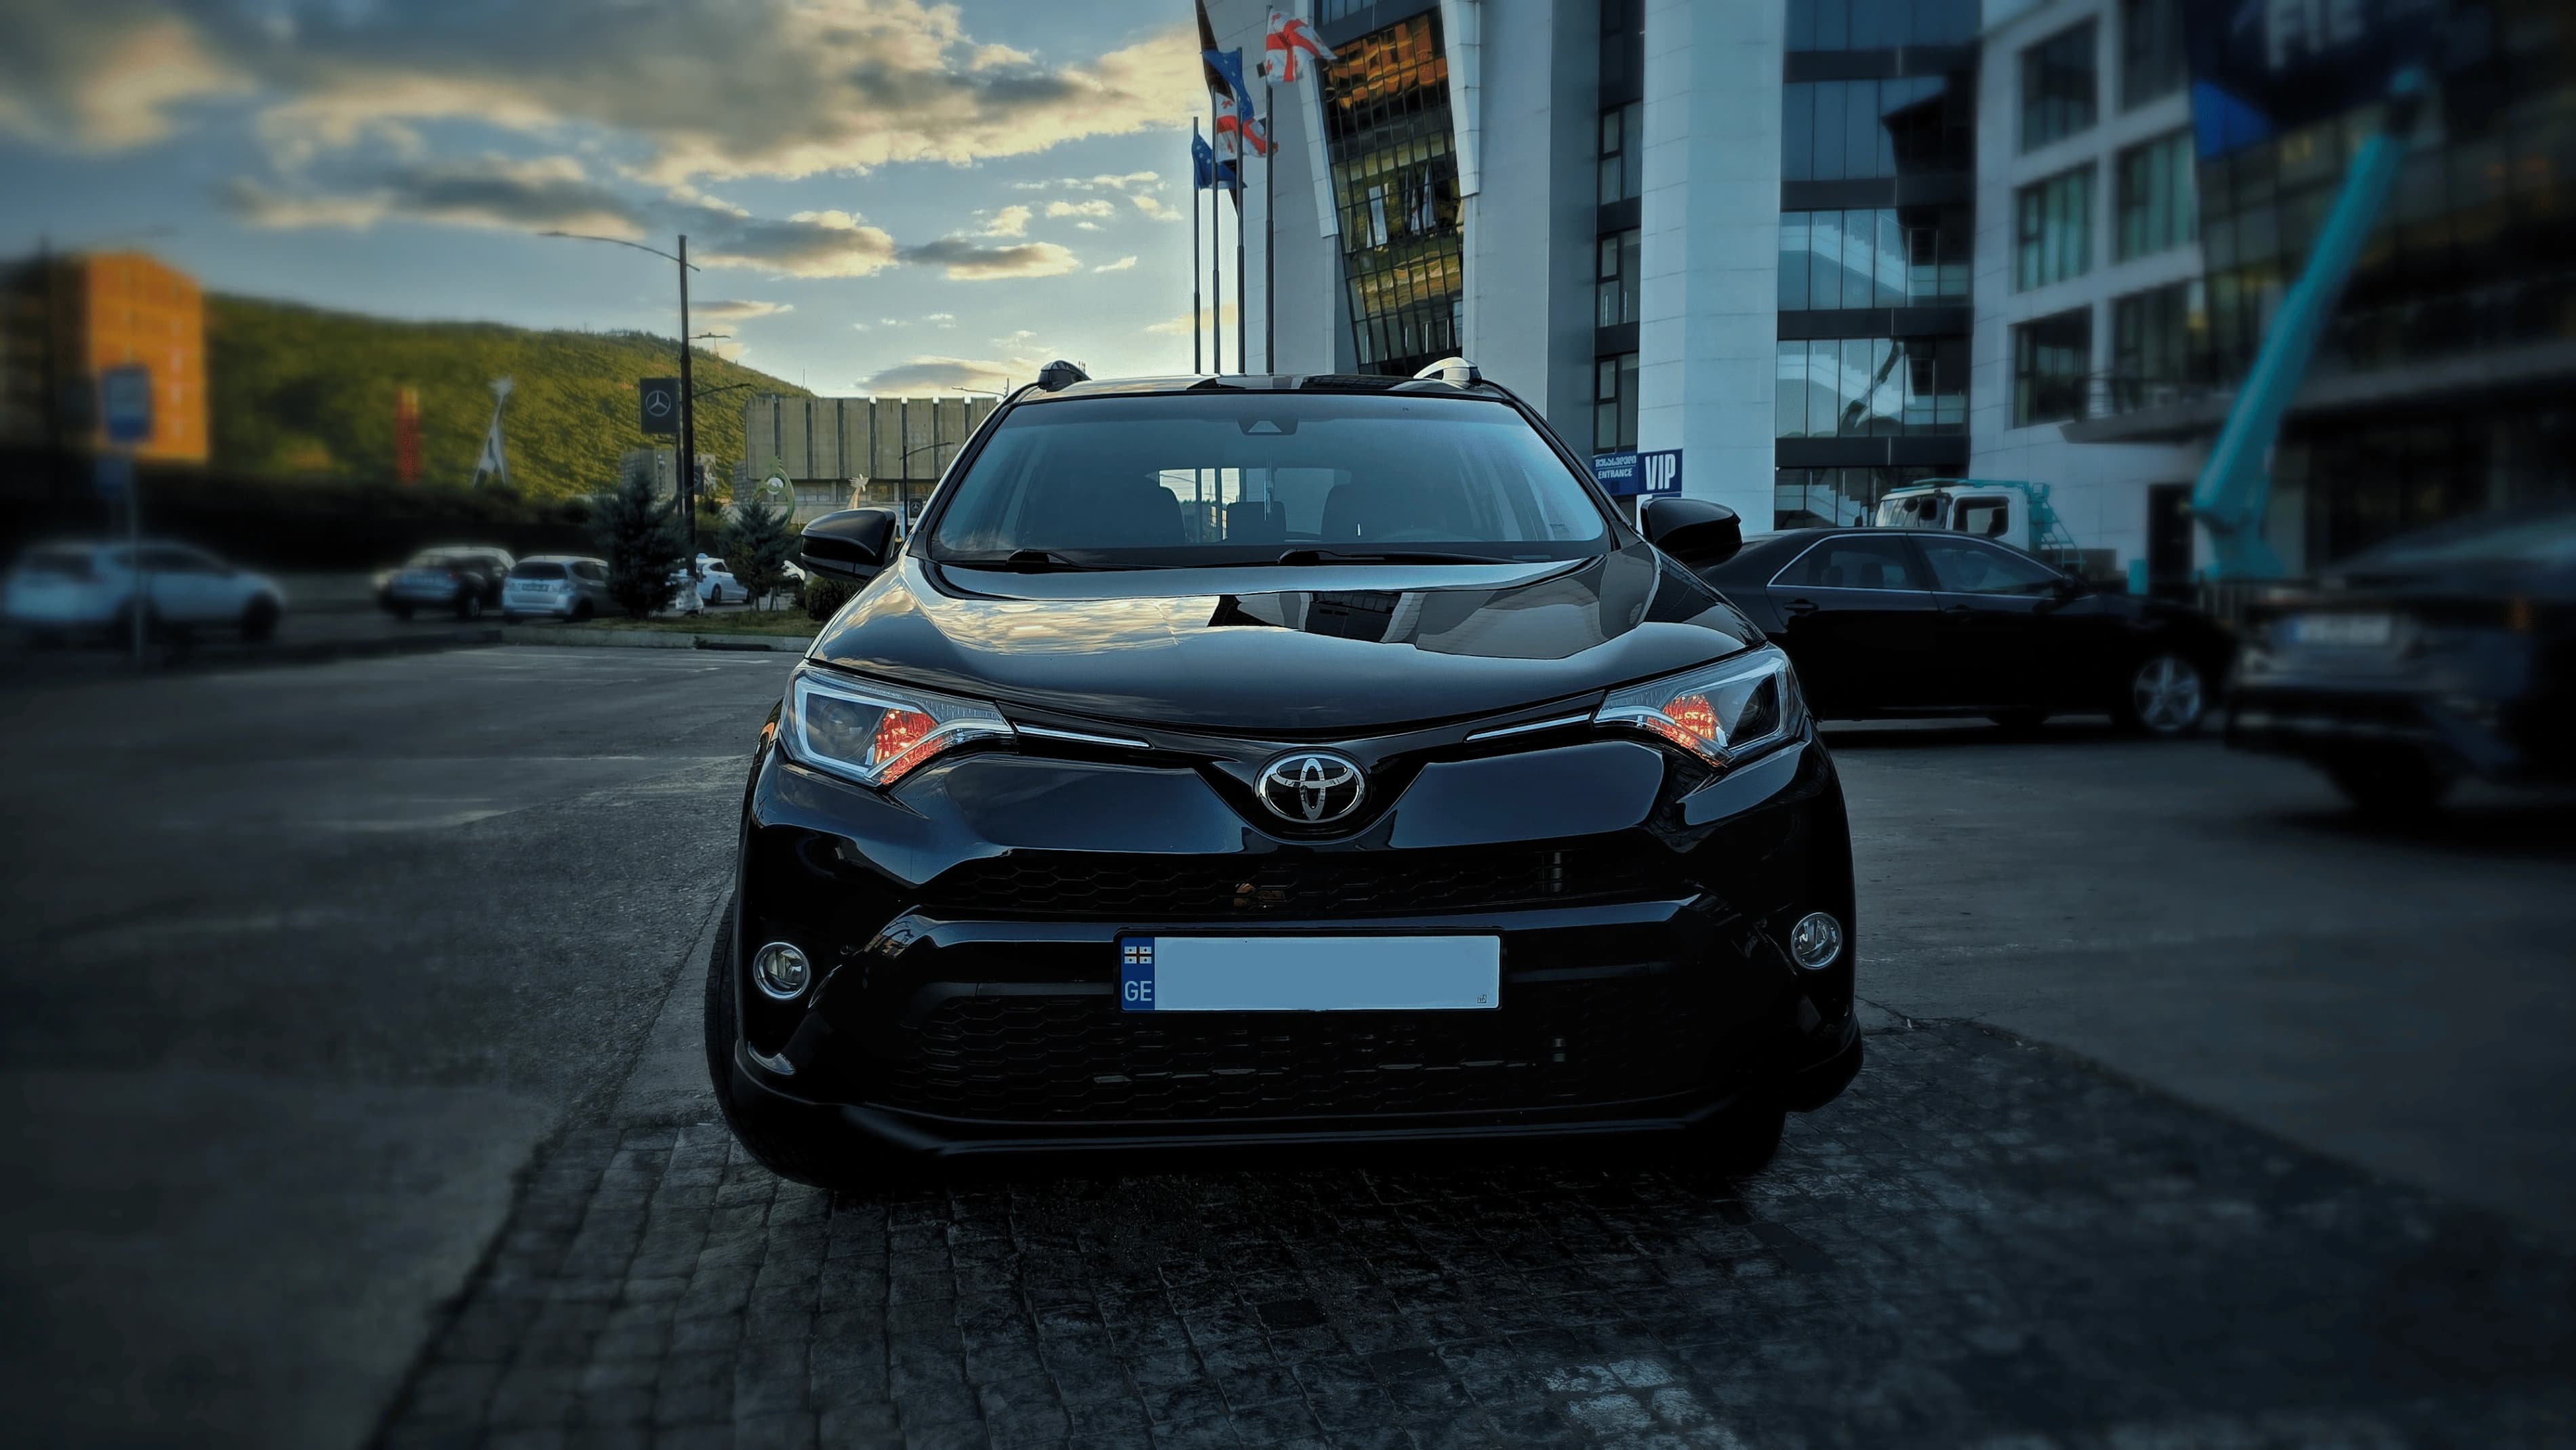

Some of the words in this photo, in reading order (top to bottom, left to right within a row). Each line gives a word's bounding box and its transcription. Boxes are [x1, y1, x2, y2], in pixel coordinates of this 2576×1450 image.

[1598, 468, 1632, 479] ENTRANCE
[1645, 454, 1676, 491] VIP
[1124, 980, 1152, 1002] GE
